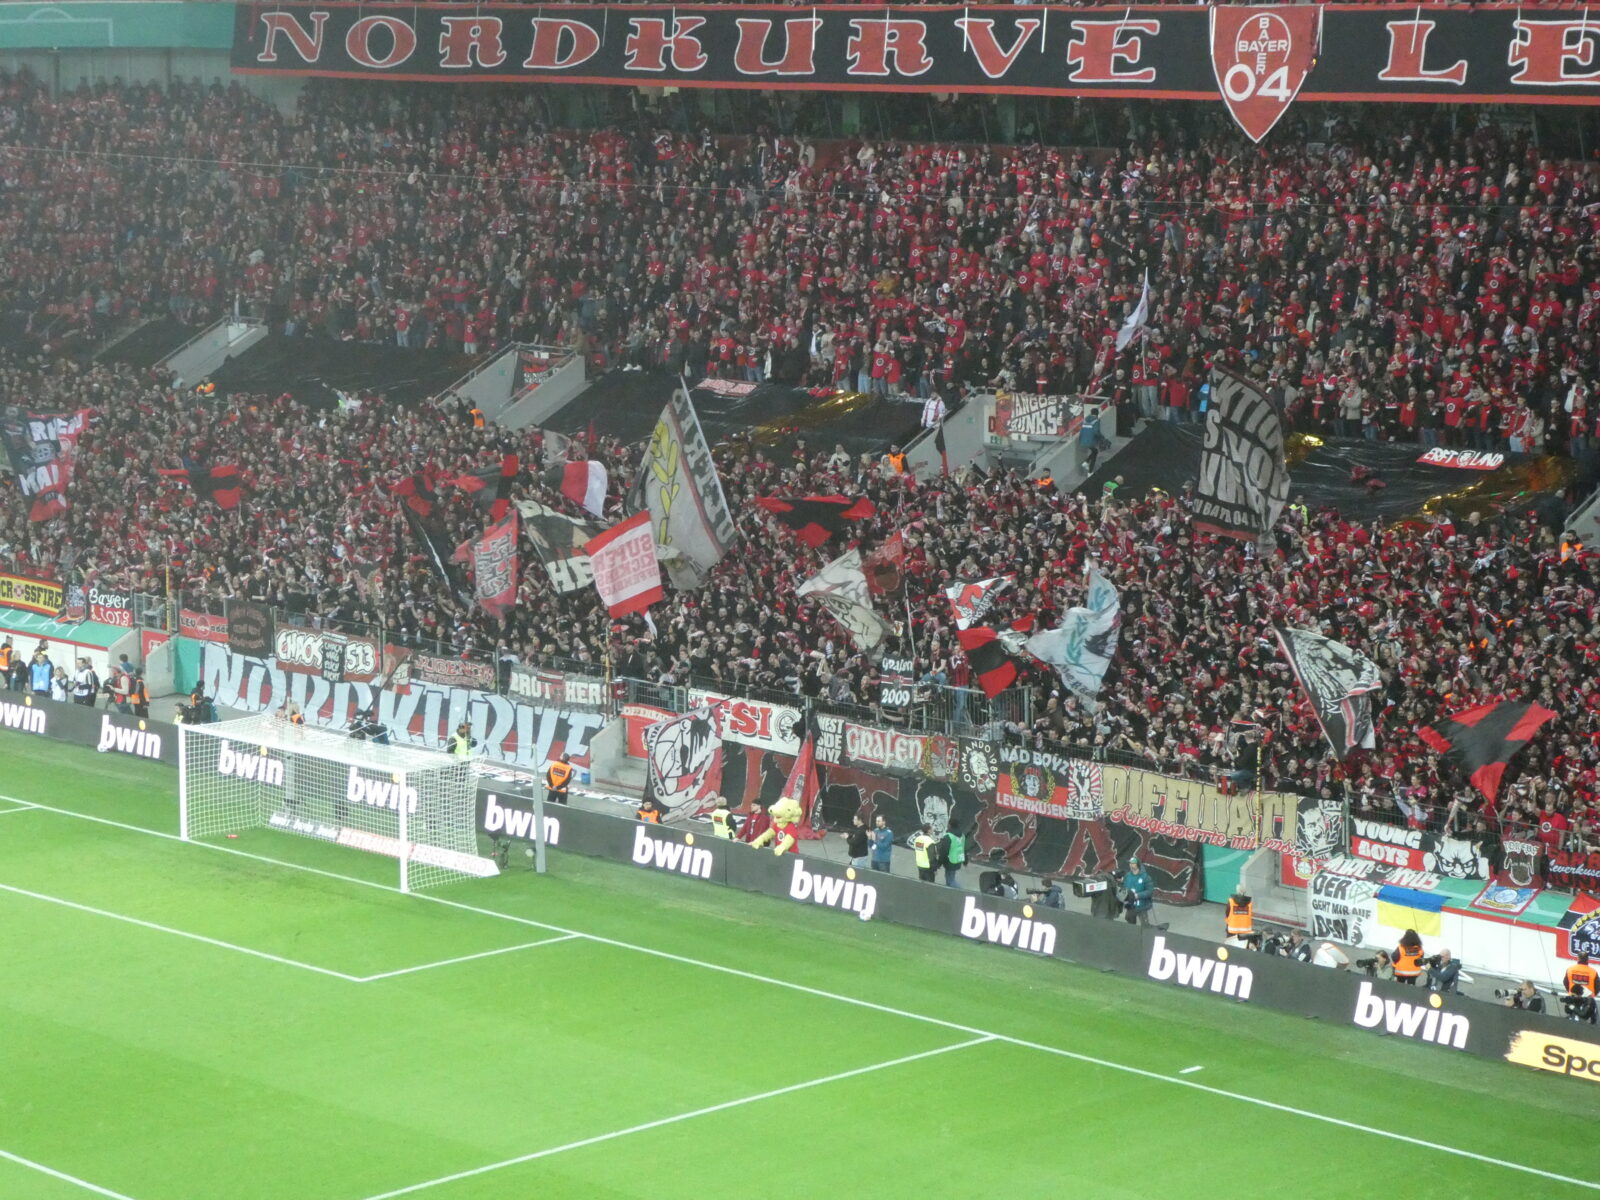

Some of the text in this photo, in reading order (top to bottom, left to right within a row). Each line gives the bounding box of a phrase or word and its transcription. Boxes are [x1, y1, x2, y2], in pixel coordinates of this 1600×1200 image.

[258, 11, 1161, 83] NORDKURVE
[1238, 40, 1288, 53] BAYER
[1224, 63, 1292, 102] 04
[344, 642, 376, 674] 513
[0, 696, 46, 734] win
[881, 688, 911, 706] 2009
[100, 714, 162, 760] bwin
[816, 714, 845, 731] WEST
[218, 740, 284, 787] bwin
[346, 766, 418, 814] bwin
[996, 792, 1068, 819] LEVERKUSEN
[632, 826, 714, 879] bwin
[1354, 817, 1423, 849] YOUNG
[1358, 840, 1410, 867] BOYS
[789, 859, 878, 915] bwin
[1313, 873, 1353, 901] DER
[960, 896, 1057, 954] bwin
[1148, 936, 1254, 999] bwin
[1353, 981, 1470, 1049] bwin
